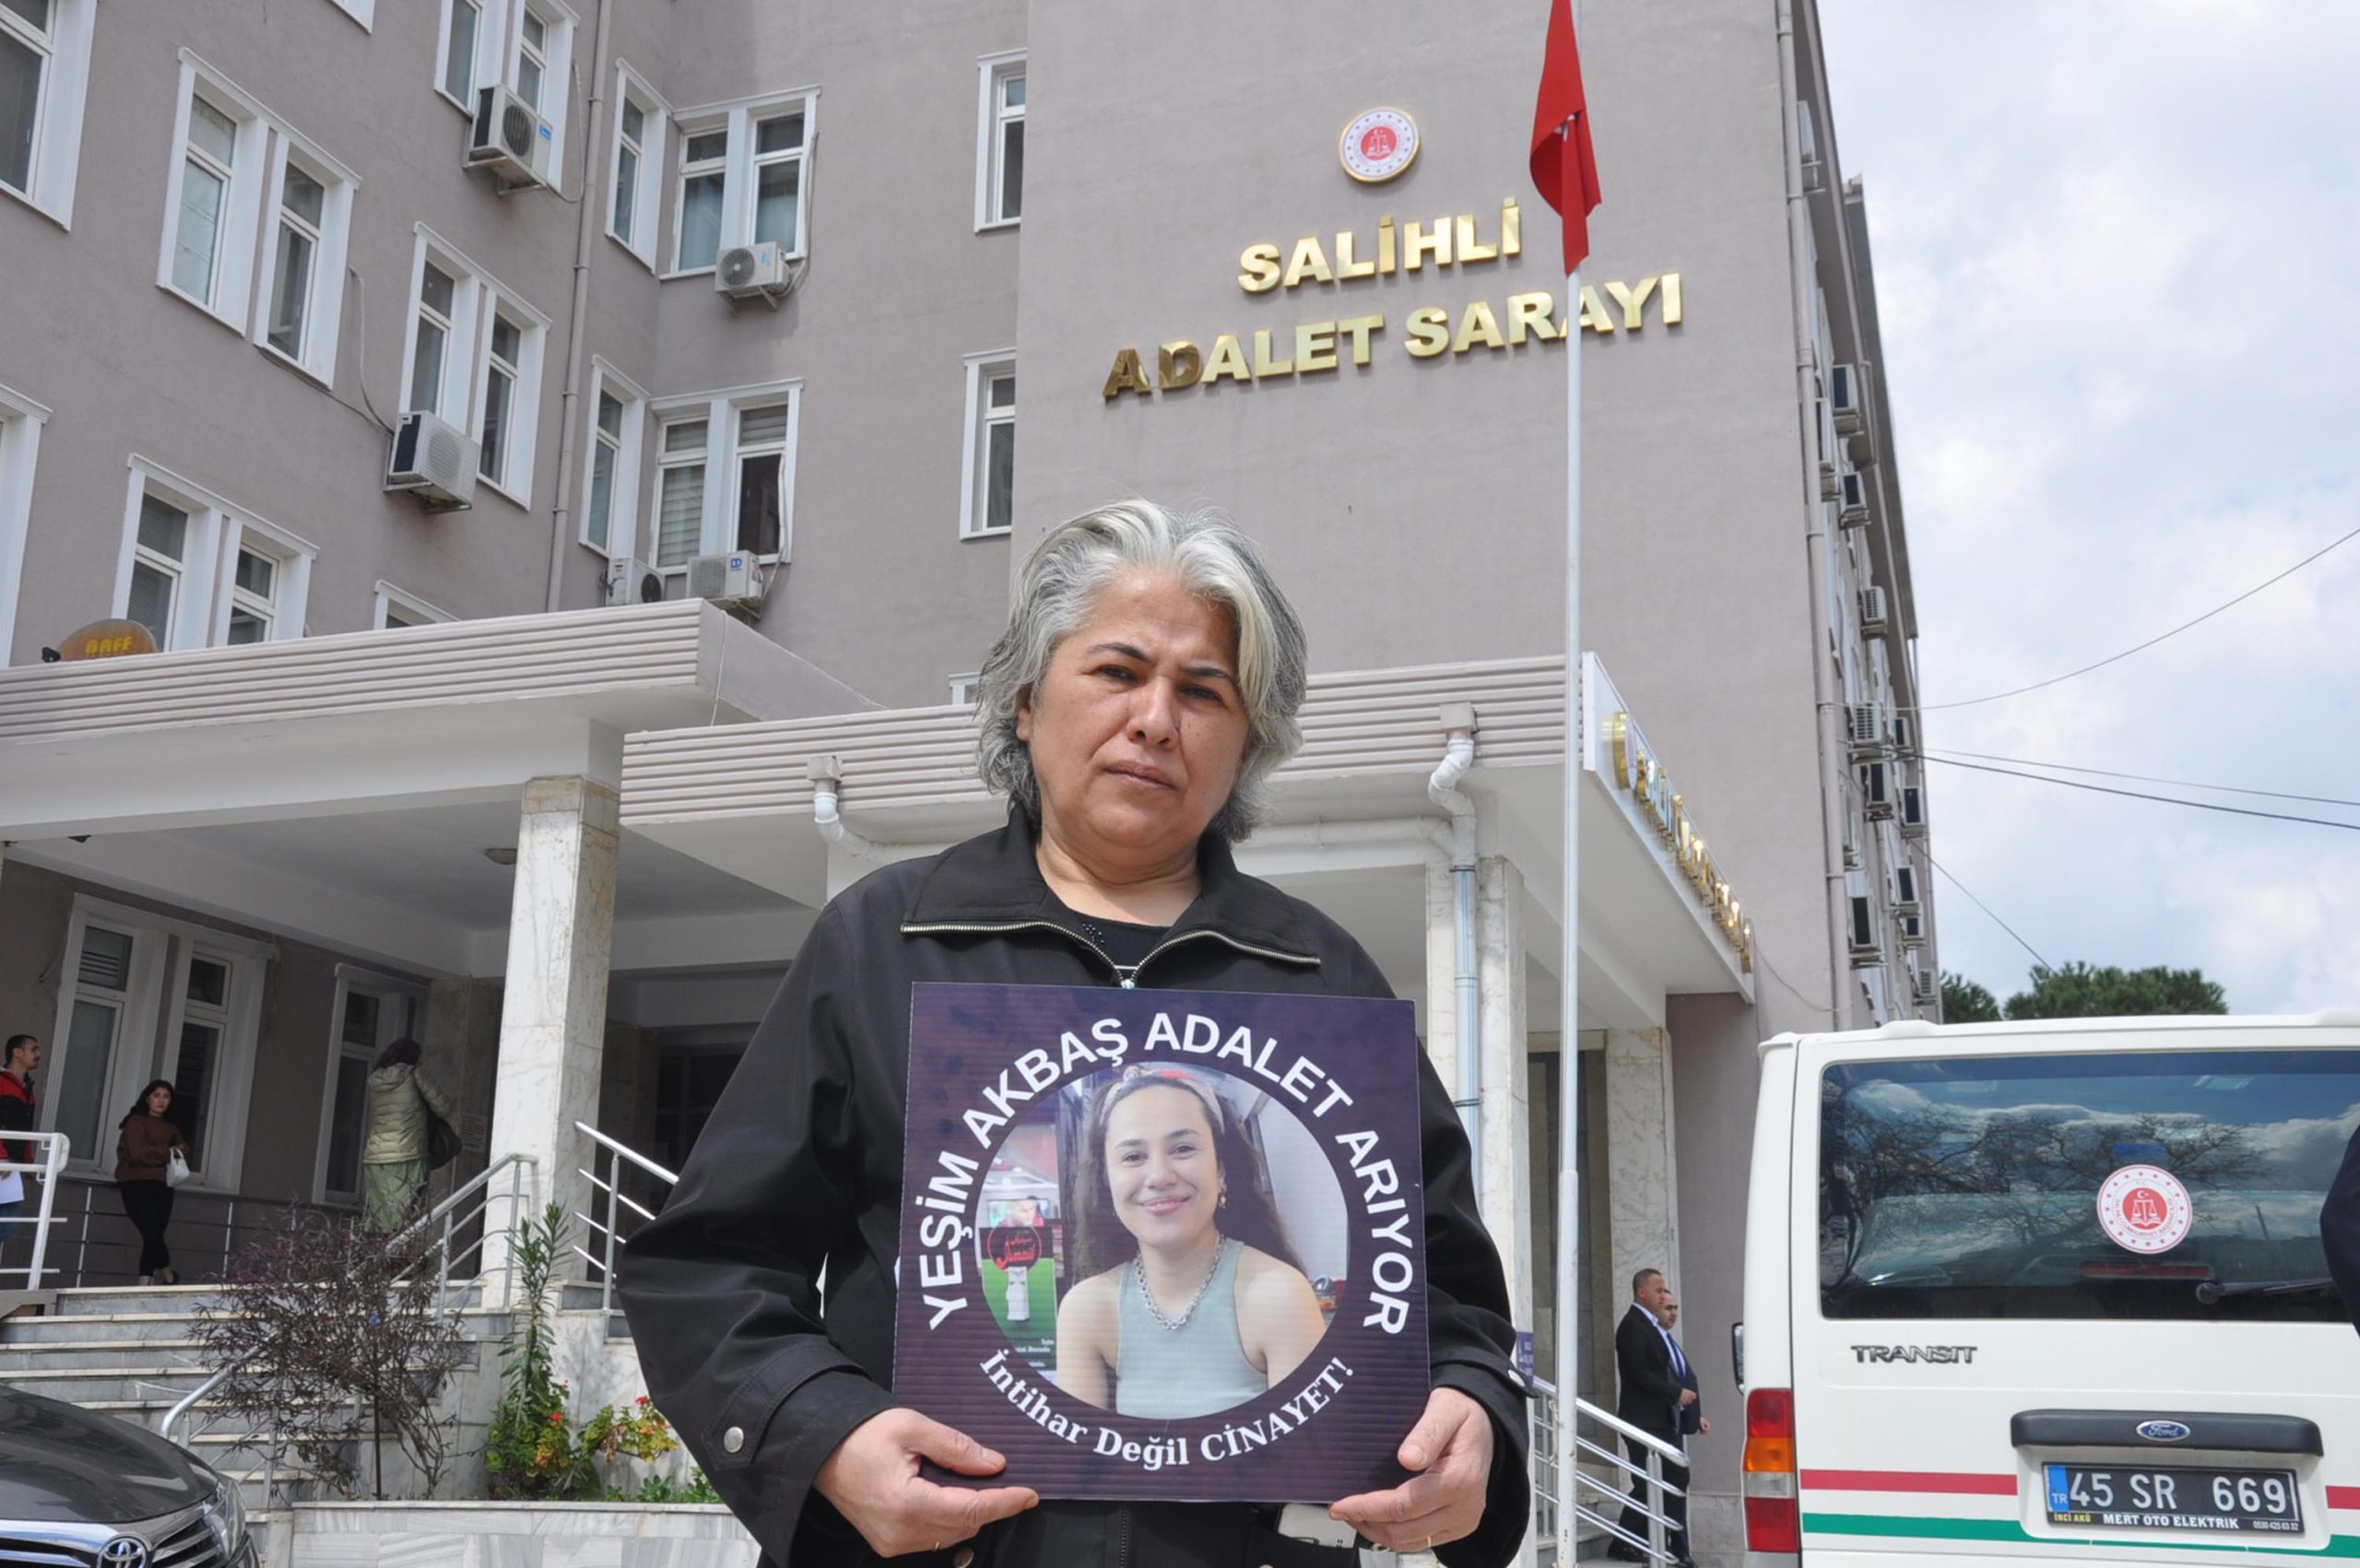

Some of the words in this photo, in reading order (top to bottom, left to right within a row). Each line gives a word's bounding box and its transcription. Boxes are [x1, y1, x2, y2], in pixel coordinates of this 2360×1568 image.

[1238, 196, 1521, 293] SALİHLİ
[1103, 314, 1385, 398] ADALET
[1404, 273, 1682, 358] SARAYI
[915, 1150, 979, 1329] YEŞİM
[962, 1018, 1128, 1149] AKBAŞ
[1144, 1012, 1353, 1118] ADALET
[1335, 1129, 1413, 1335] ARIYOR
[1850, 1346, 1977, 1363] TRANSIT
[980, 1349, 1087, 1444] İntihar
[1092, 1428, 1189, 1472] Değil
[1200, 1357, 1355, 1462] CİNAYET!
[2147, 1422, 2179, 1436] Ford
[2052, 1493, 2068, 1503] TR
[2070, 1473, 2114, 1507] 45
[2130, 1474, 2177, 1509] SR
[2212, 1476, 2286, 1514] 669
[2103, 1514, 2140, 1525] MERT
[2143, 1515, 2170, 1527] OTO
